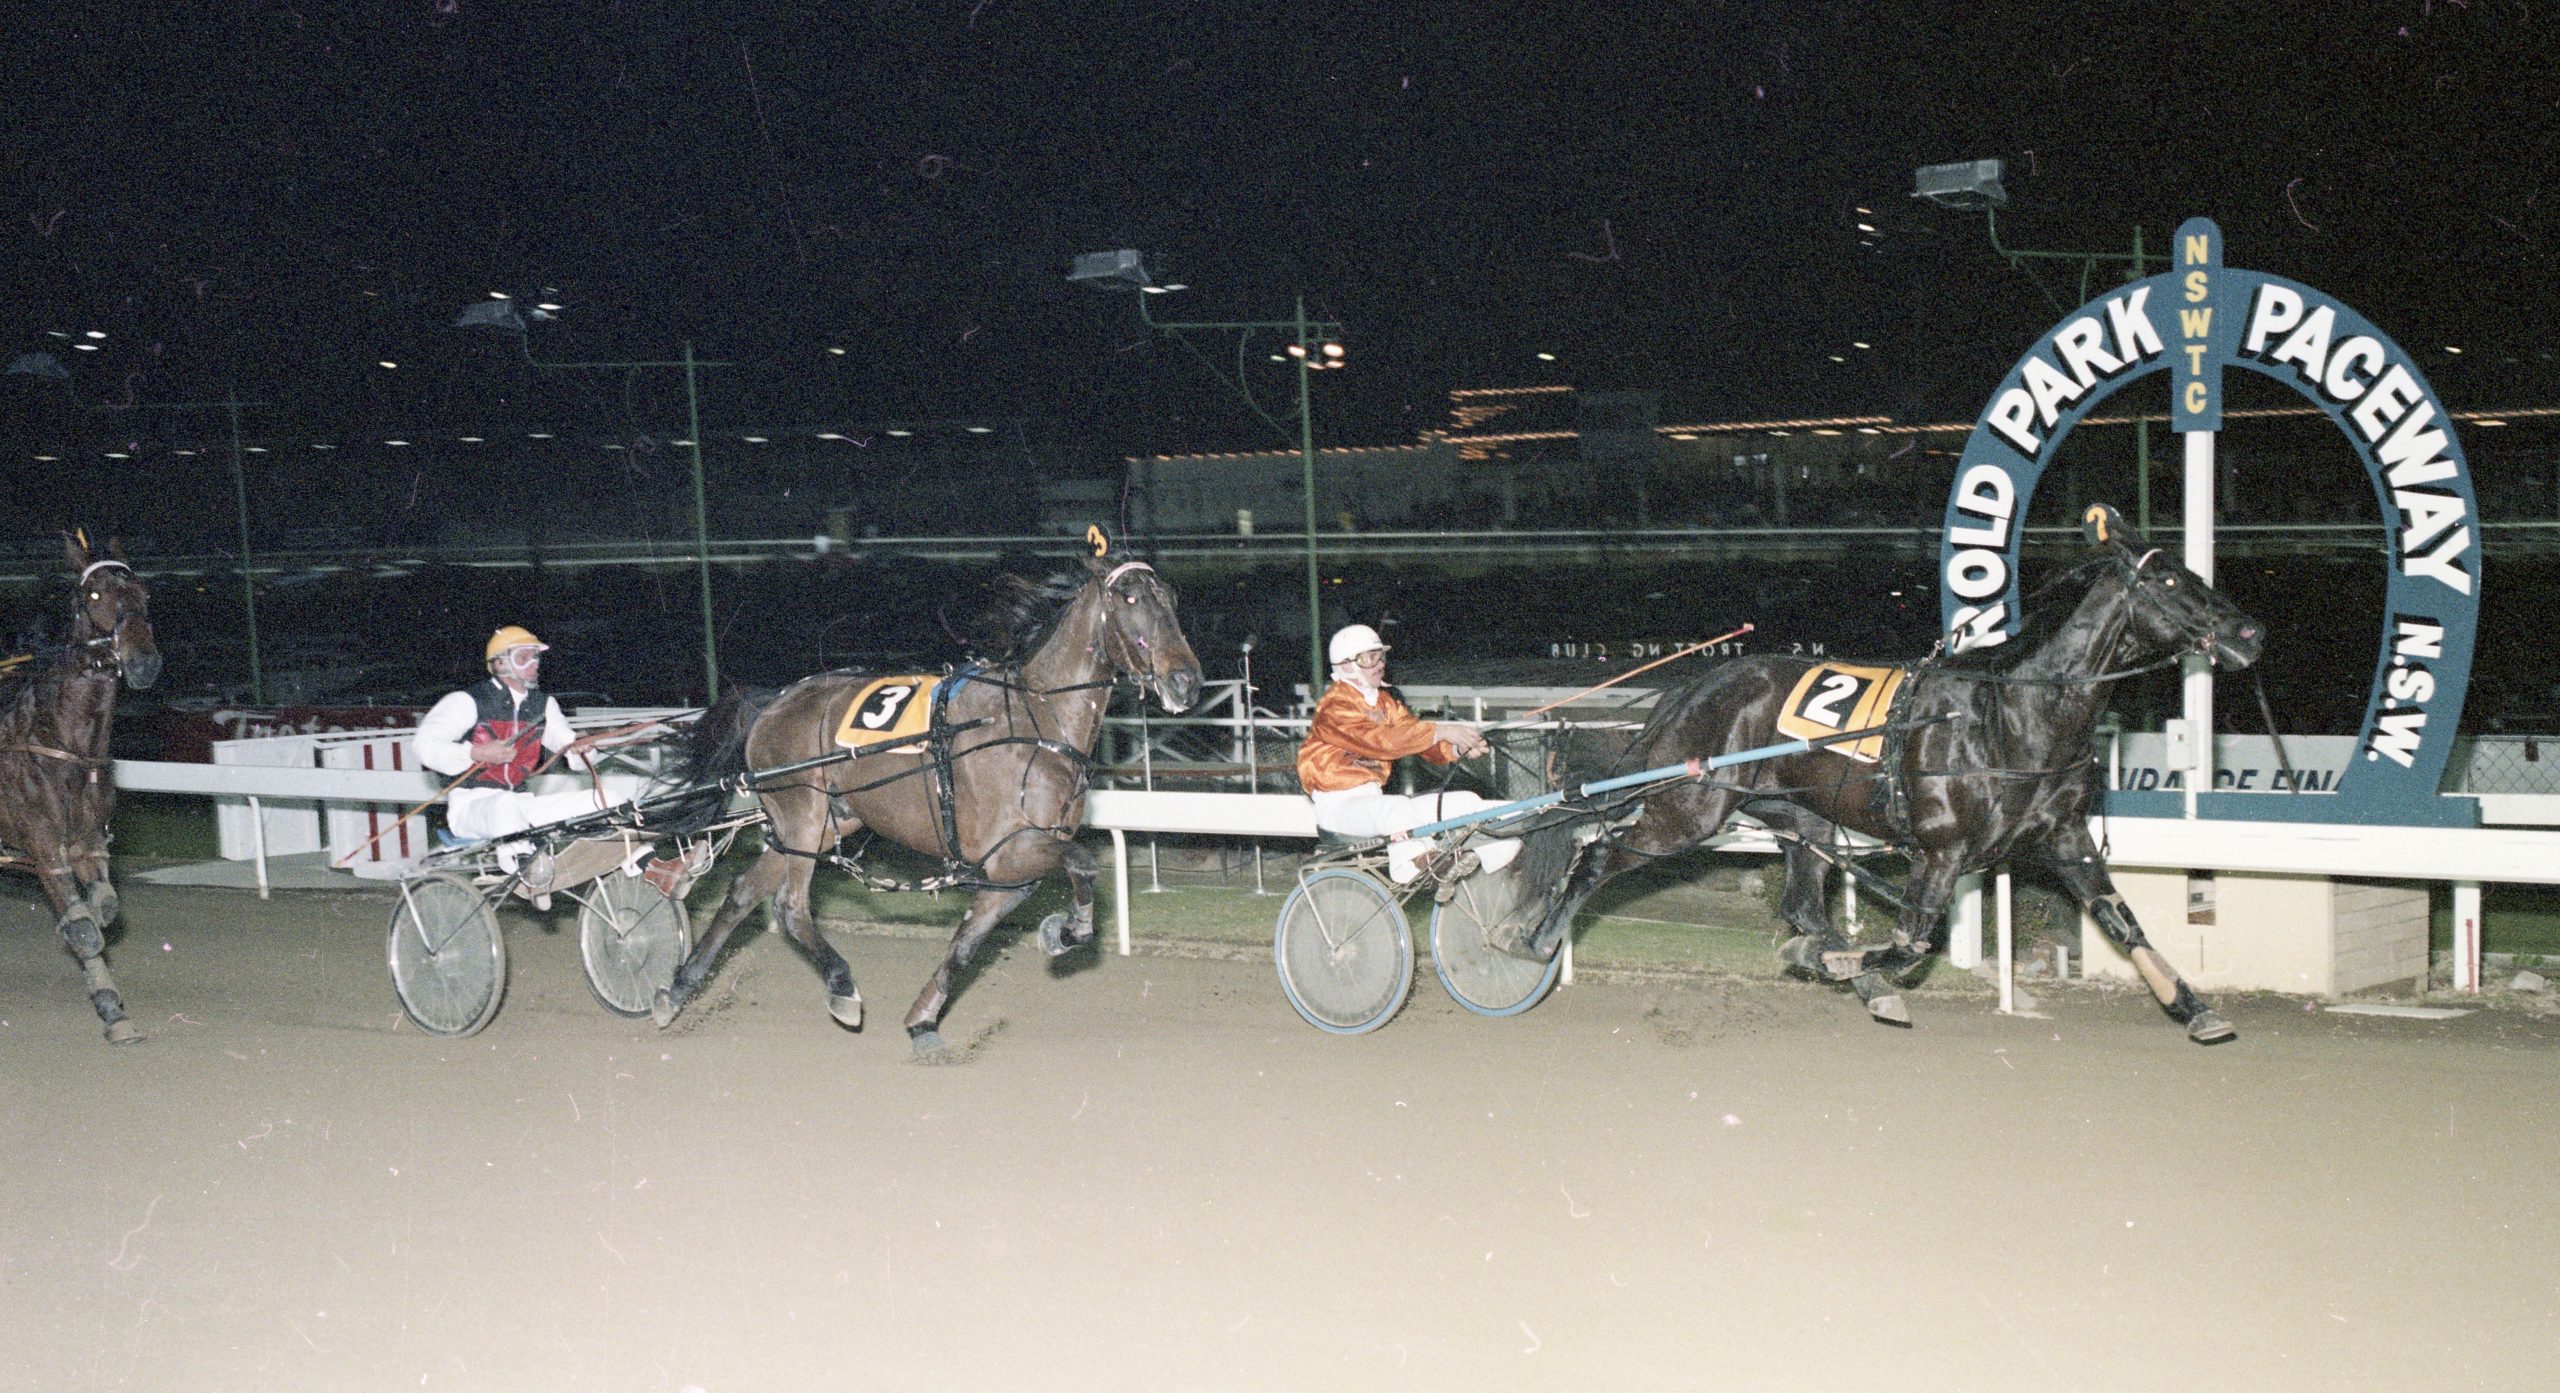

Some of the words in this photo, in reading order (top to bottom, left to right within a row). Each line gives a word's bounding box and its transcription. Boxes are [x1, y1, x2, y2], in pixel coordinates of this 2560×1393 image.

[2181, 236, 2211, 413] NSWTC
[1087, 525, 1107, 557] 3
[1947, 465, 2014, 655] ROLD
[1988, 287, 2164, 453] PARK
[2247, 284, 2471, 595] PACEWAY
[2367, 623, 2444, 768] N.S.W.
[862, 685, 911, 729] 3
[1803, 674, 1858, 728] 2
